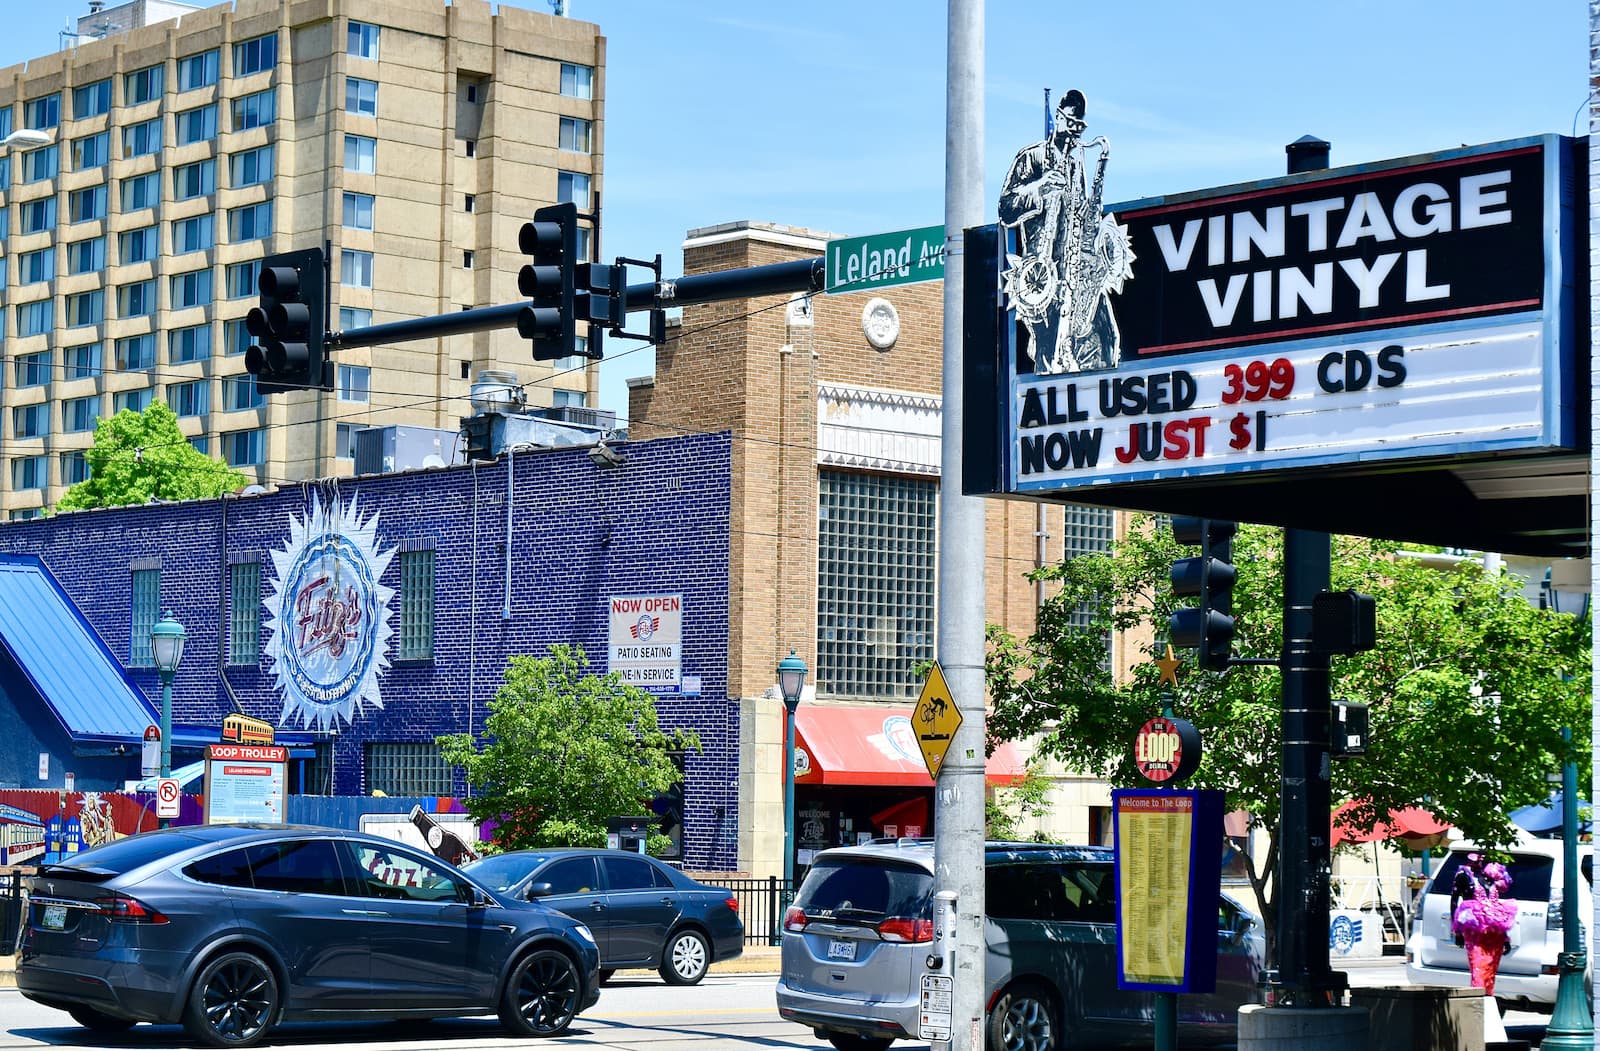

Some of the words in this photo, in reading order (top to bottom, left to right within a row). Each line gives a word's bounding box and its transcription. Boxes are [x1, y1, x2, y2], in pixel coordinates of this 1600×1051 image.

[1151, 169, 1512, 273] VINTAGE
[834, 236, 912, 287] Leland
[1197, 248, 1450, 328] VINYL
[1019, 383, 1089, 428] ALL
[1099, 370, 1198, 418] USED
[1221, 357, 1295, 405] 399
[1317, 344, 1408, 394] CDS
[1020, 426, 1103, 475] NOW
[1115, 416, 1211, 464] JUST
[1229, 410, 1266, 452] $1
[612, 599, 642, 614] NOW
[645, 597, 679, 612] OPEN
[617, 647, 639, 659] PATIO
[640, 646, 672, 659] SEATING
[622, 668, 641, 681] NE-IN
[643, 668, 674, 680] SERVICE
[210, 747, 238, 757] LOOP
[240, 748, 284, 759] TROLLEY
[1138, 732, 1180, 763] LOOP
[1148, 762, 1168, 770] DELMAR
[1120, 798, 1150, 808] Welcome
[1152, 799, 1160, 808] to
[1161, 798, 1173, 808] The
[1175, 799, 1193, 809] Loop
[798, 810, 831, 818] WELCOME
